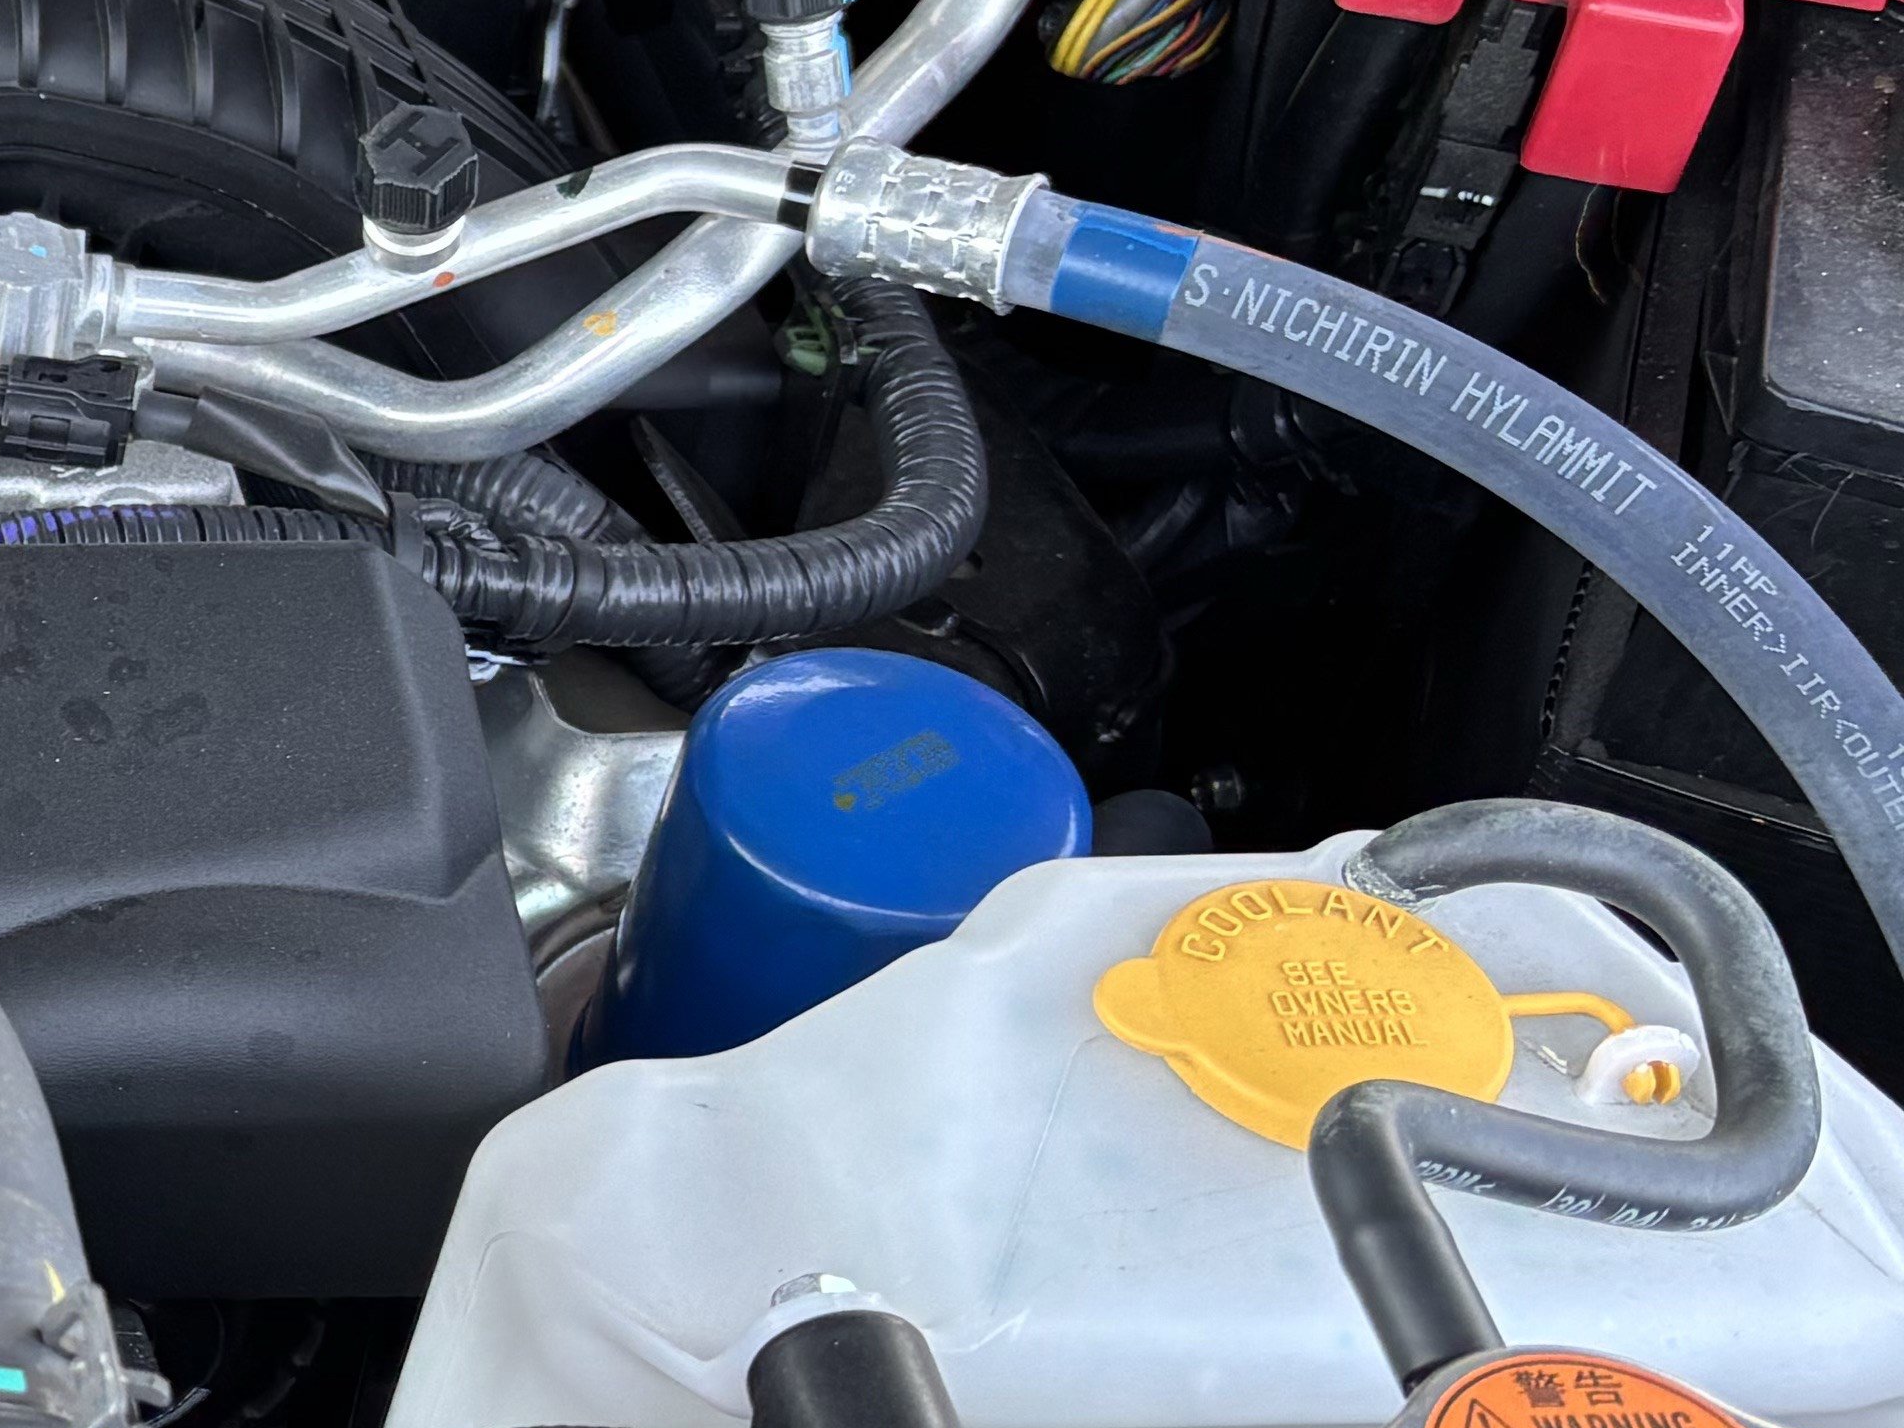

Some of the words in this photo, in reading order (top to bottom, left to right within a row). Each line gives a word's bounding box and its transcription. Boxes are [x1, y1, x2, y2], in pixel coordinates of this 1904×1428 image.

[1450, 370, 1659, 517] HYLAMMIT
[1179, 884, 1451, 964] COOLANT
[1281, 960, 1359, 988] SEE
[1270, 989, 1418, 1018] OWNERS
[1281, 1020, 1431, 1047] MANUAL
[1513, 1369, 1627, 1408] 警告
